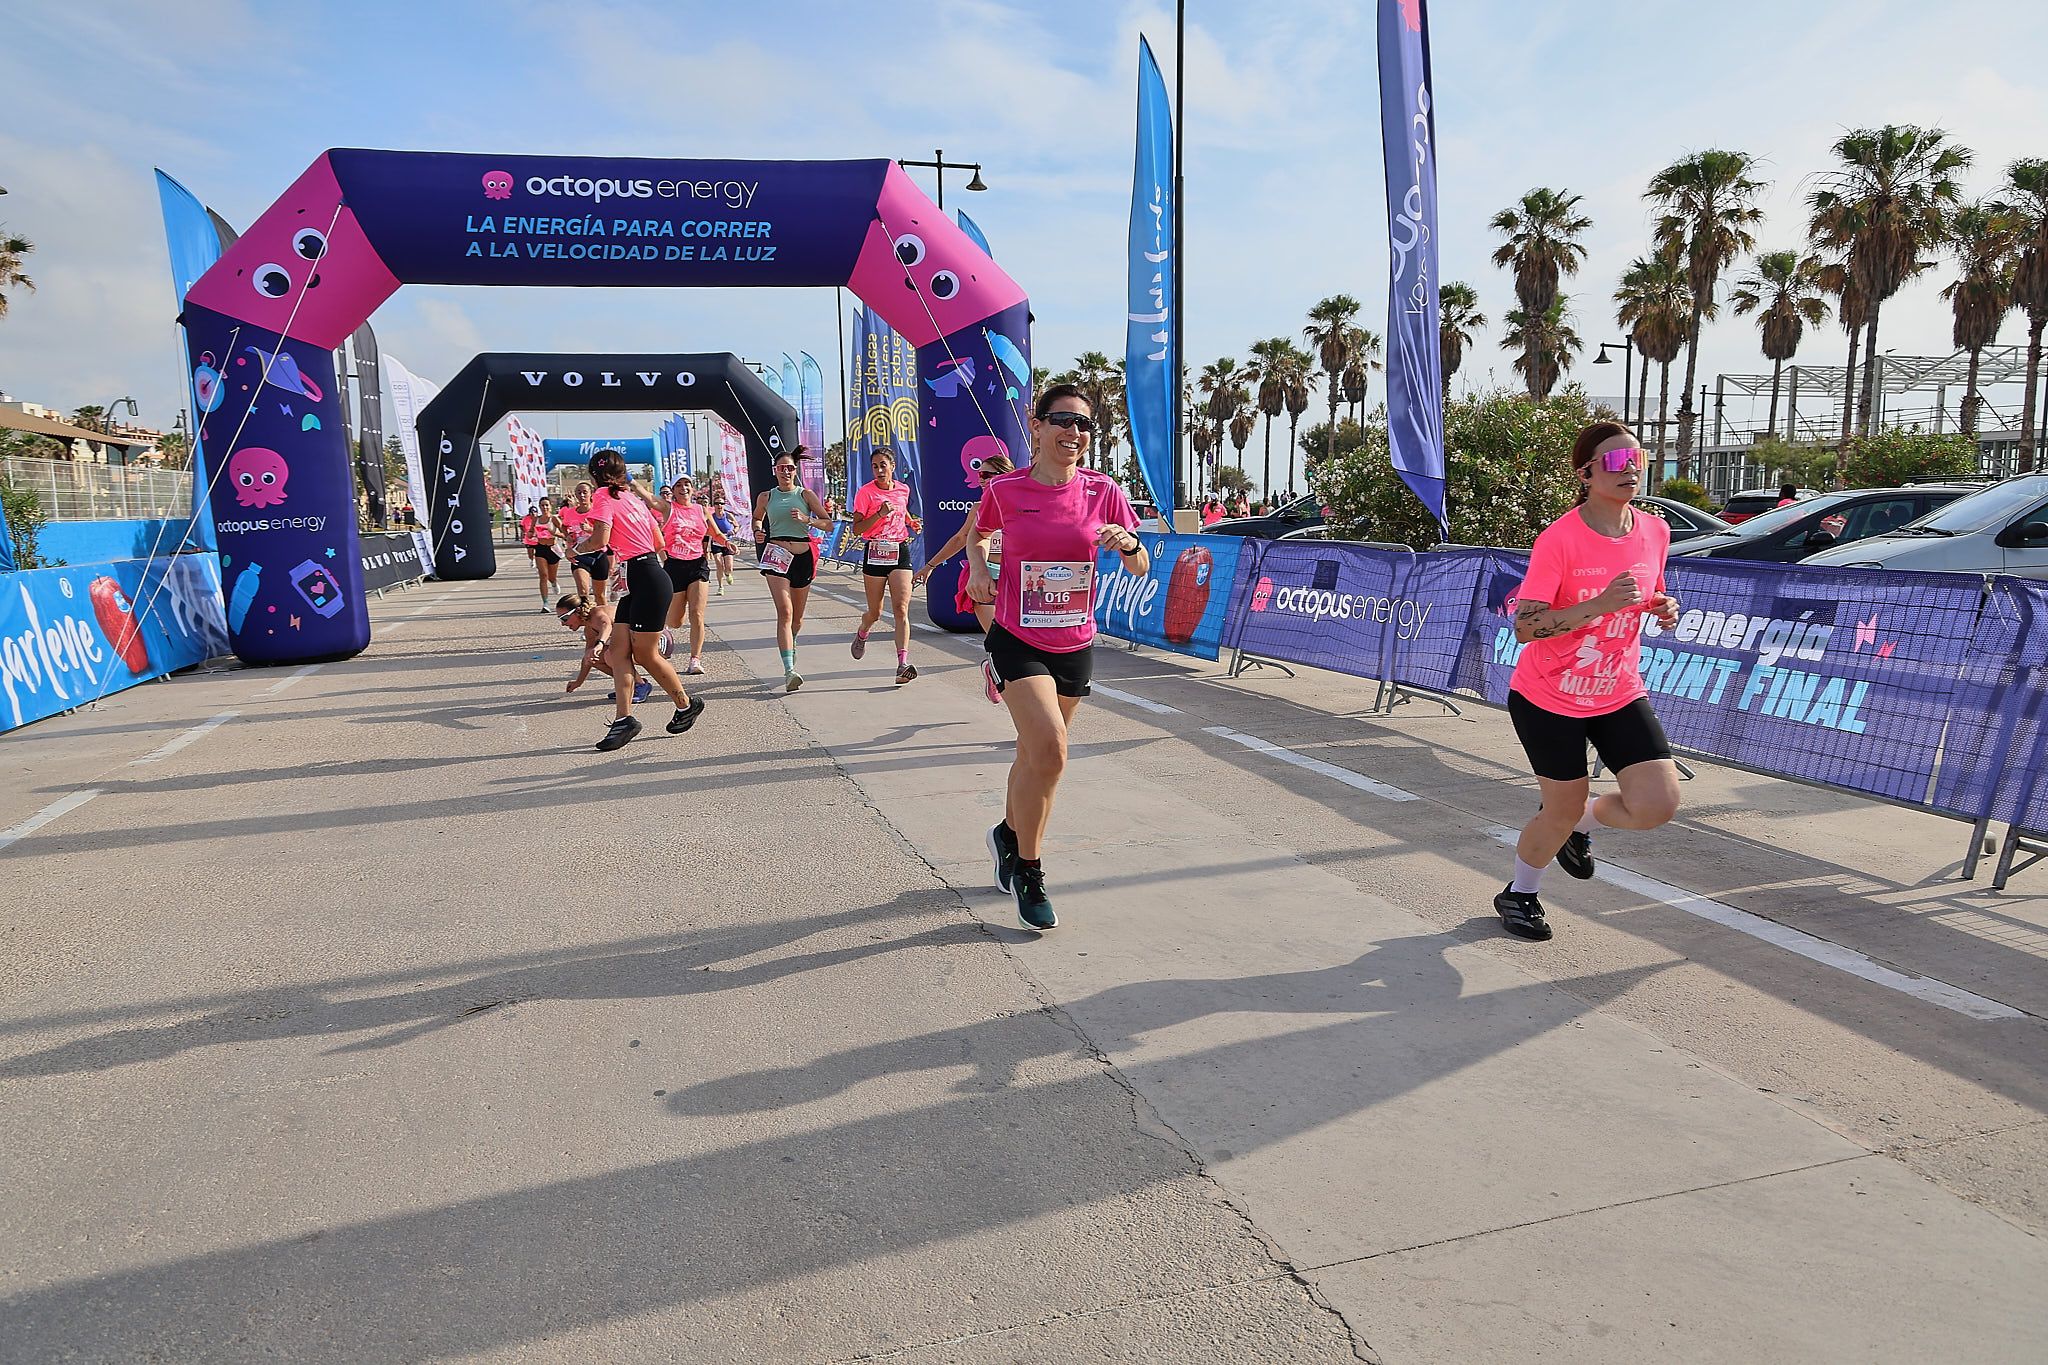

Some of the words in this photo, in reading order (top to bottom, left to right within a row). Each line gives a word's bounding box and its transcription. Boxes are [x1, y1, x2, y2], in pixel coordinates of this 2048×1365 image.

[525, 175, 653, 203] octopus
[657, 179, 759, 209] energy
[465, 215, 496, 234] LA
[503, 213, 606, 237] ENERGÍA
[612, 219, 675, 238] PARA
[681, 220, 772, 239] CORRER
[465, 241, 483, 258] A
[489, 242, 520, 259] LA
[526, 242, 659, 261] VELOCIDAD
[664, 245, 695, 261] DE
[699, 245, 728, 262] LA
[733, 246, 777, 262] LUZ
[520, 371, 696, 387] VOLVO
[439, 439, 468, 563] VOLVO
[217, 518, 270, 535] octopus
[270, 515, 327, 532] energy
[1572, 566, 1608, 577] OYSHO
[1044, 592, 1071, 604] 016
[1094, 558, 1159, 632] rlene
[1276, 586, 1352, 623] octopus
[1352, 594, 1433, 641] energy
[1674, 608, 1835, 667] energía
[0, 581, 102, 727] arlene
[1559, 671, 1618, 696] MUJER
[1737, 664, 1870, 735] FINAL
